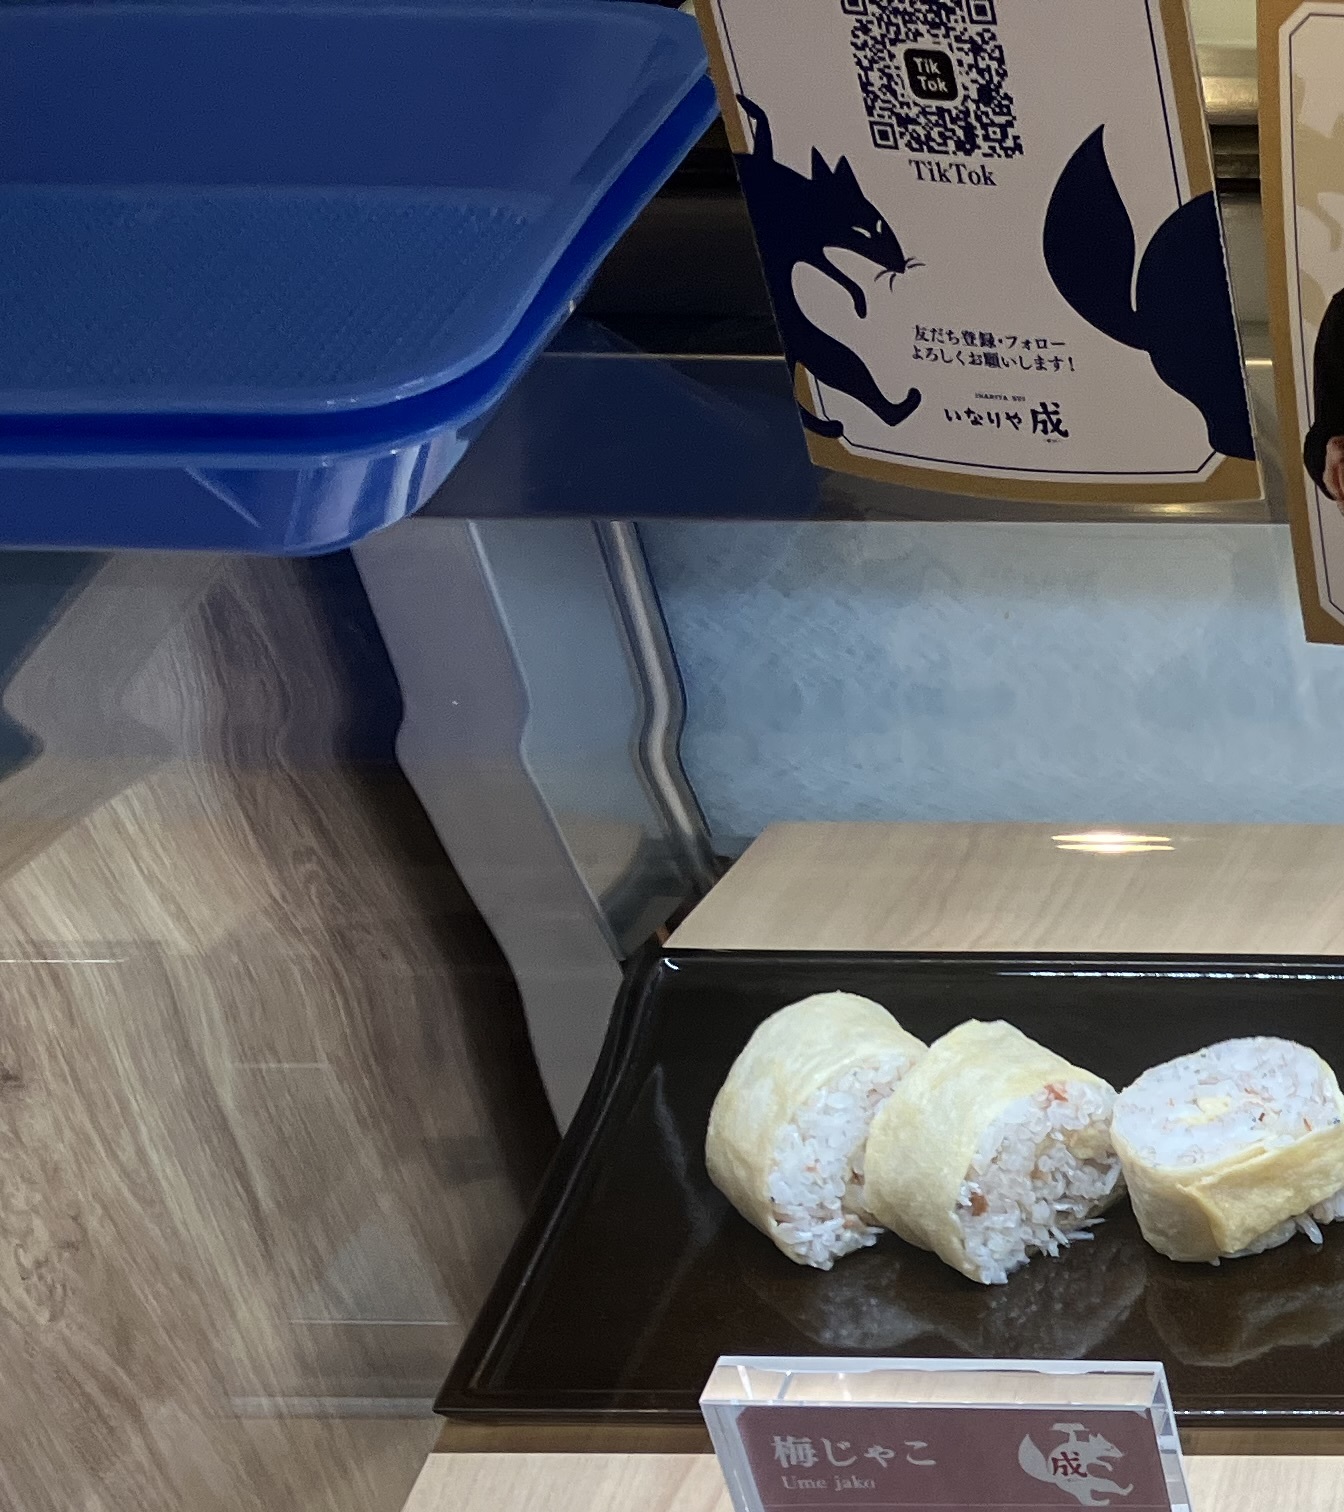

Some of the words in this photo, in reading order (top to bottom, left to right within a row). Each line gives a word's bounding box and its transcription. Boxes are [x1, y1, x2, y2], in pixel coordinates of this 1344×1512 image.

[913, 57, 941, 75] Tik
[917, 76, 948, 93] Tok
[908, 159, 997, 187] TikTok
[944, 402, 1069, 438] いなりや成
[771, 1435, 937, 1468] 梅じゃこ
[1051, 1451, 1088, 1478] 成
[781, 1476, 828, 1490] Ume
